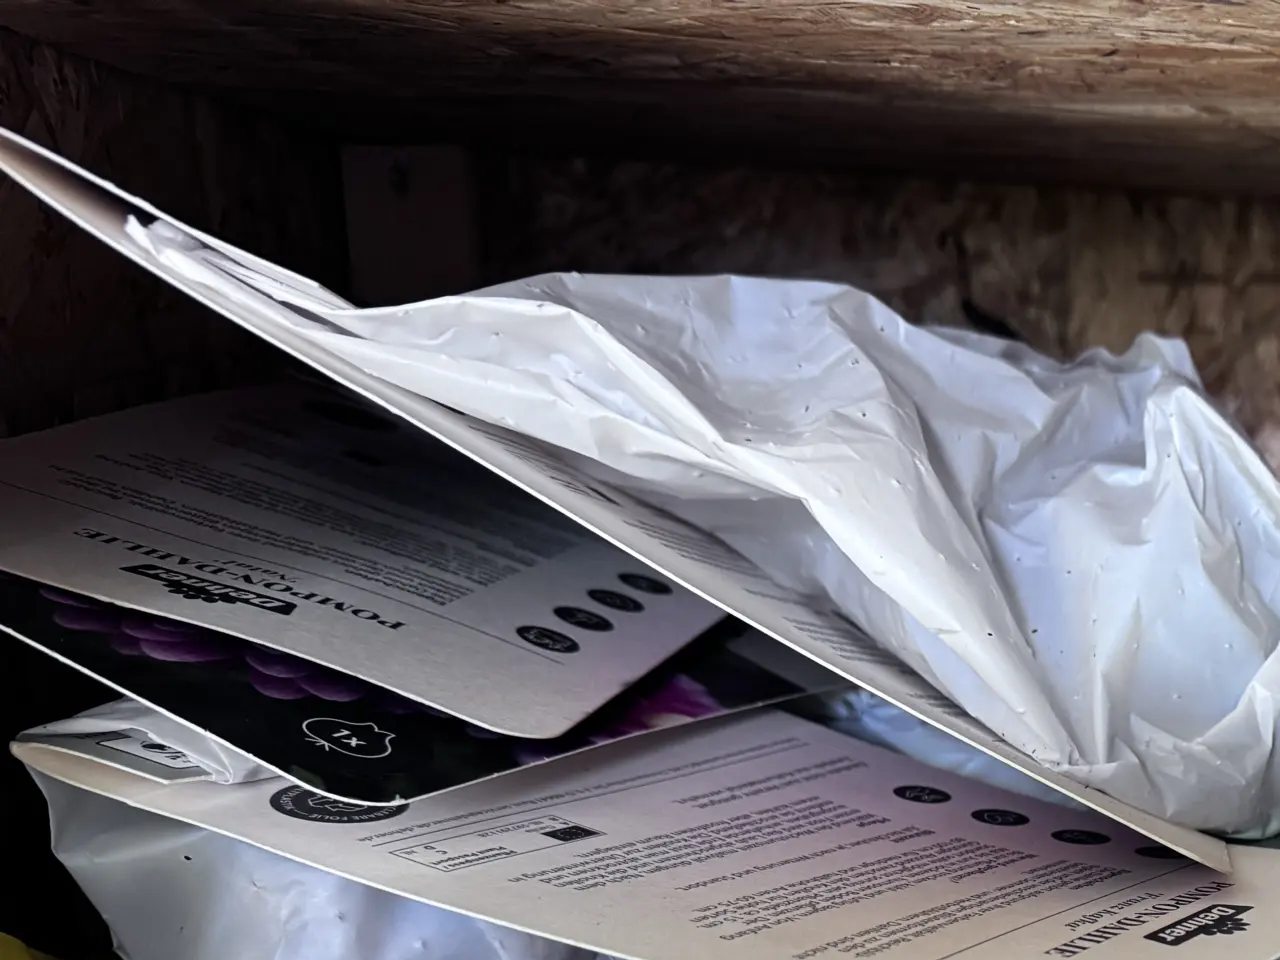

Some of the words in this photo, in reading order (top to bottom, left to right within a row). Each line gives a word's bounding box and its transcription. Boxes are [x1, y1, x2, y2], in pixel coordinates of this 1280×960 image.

[71, 518, 412, 632] POMPON-DAHLIE
[138, 559, 285, 612] Dehner
[331, 728, 368, 748] 1x
[1036, 879, 1240, 960] POMPON-DAHLIE
[1148, 905, 1239, 942] Dehner
